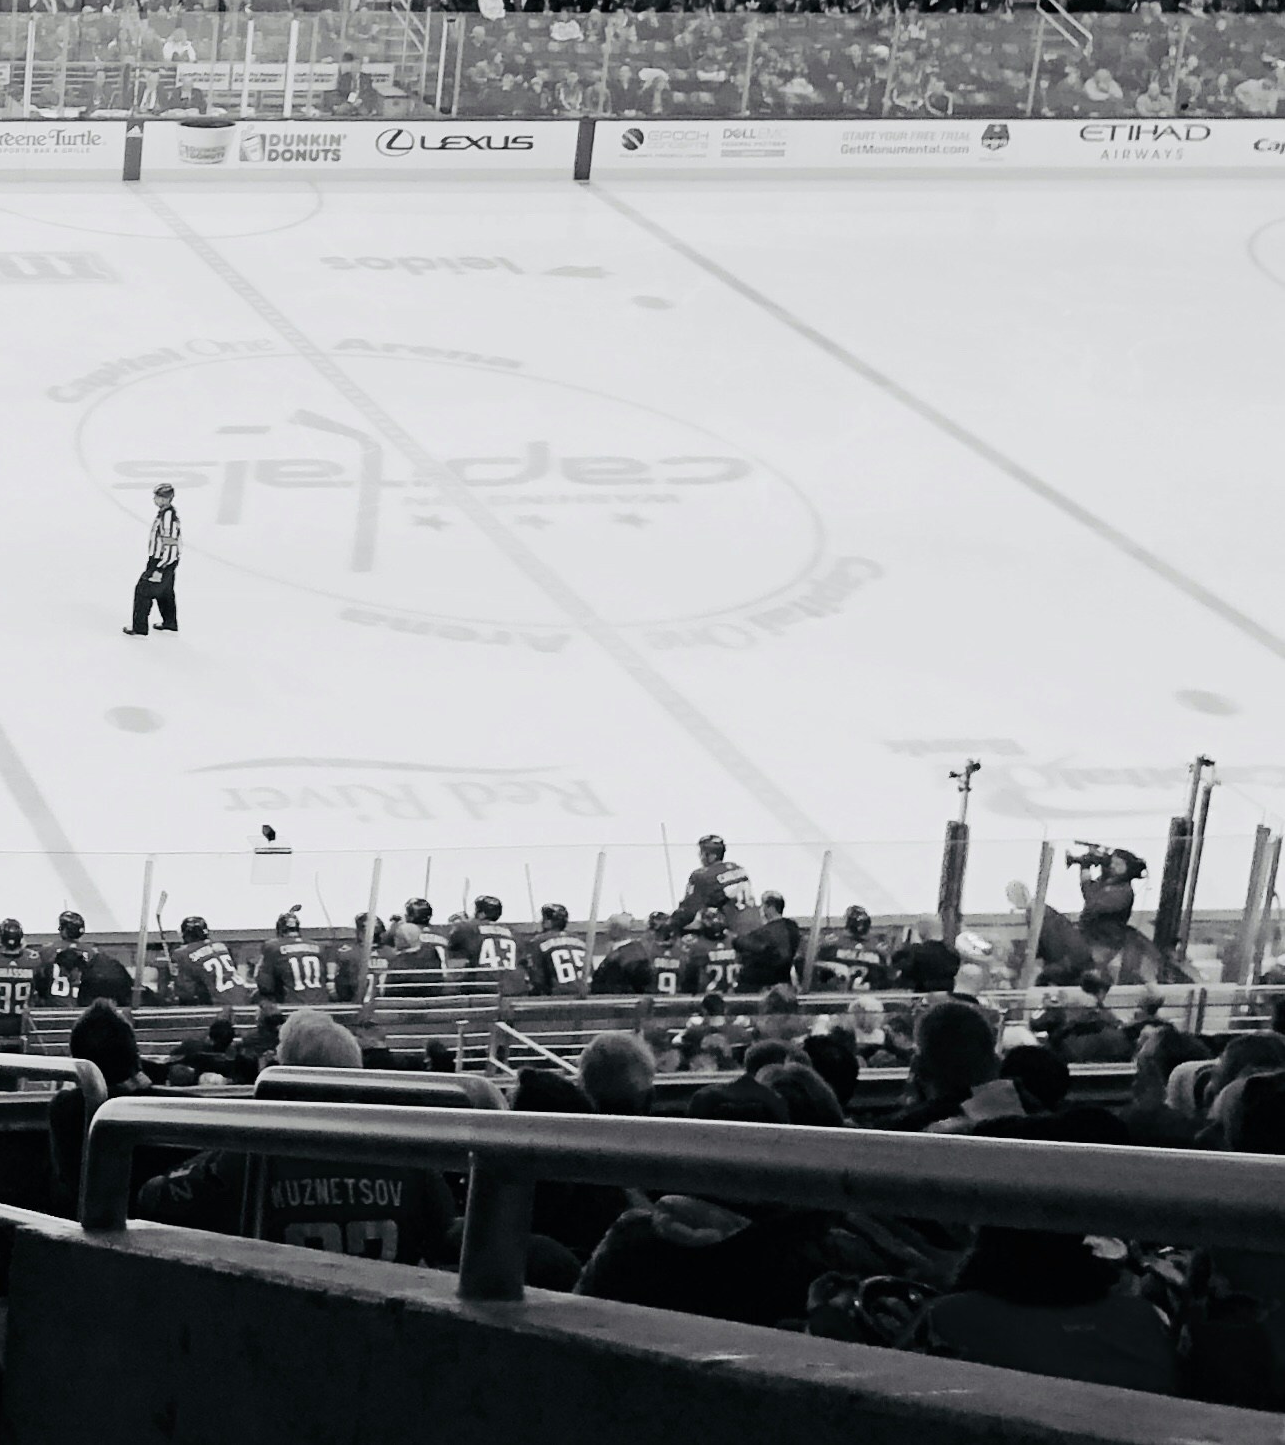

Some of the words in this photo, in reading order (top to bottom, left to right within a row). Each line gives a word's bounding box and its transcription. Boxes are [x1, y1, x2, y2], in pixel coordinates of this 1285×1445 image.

[48, 128, 102, 146] Turtle
[268, 133, 348, 148] DUNKIN'
[648, 130, 709, 141] EPOCH
[723, 128, 756, 139] DELL
[1079, 124, 1211, 142] ETIHAD
[420, 135, 534, 151] LEXUS
[267, 148, 342, 163] DONUTS
[1100, 148, 1183, 161] AIRWAYS
[332, 337, 524, 370] Arena
[219, 778, 408, 823] River
[448, 778, 618, 819] Red
[478, 938, 517, 970] 43
[289, 955, 322, 990] 10
[270, 1177, 403, 1209] KUZNETSOV
